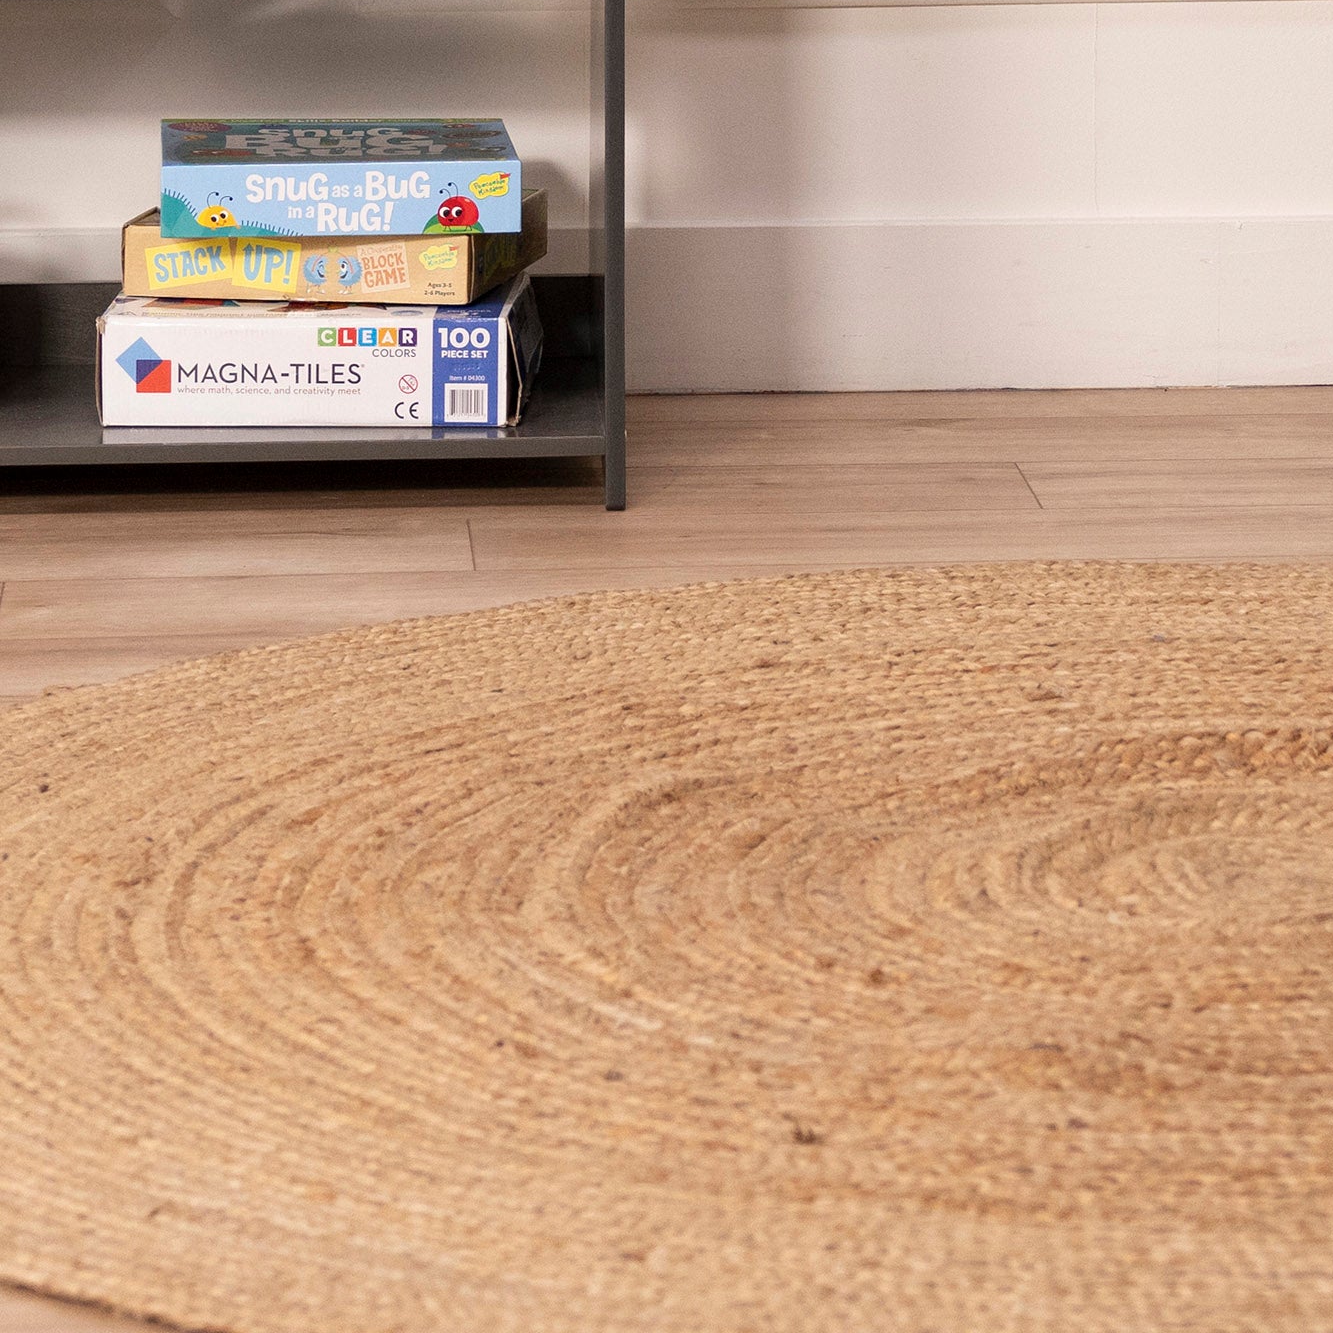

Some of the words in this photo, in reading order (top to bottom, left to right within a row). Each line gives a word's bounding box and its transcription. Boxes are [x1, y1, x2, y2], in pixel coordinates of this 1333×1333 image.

[332, 184, 350, 198] as
[353, 184, 363, 198] a
[287, 206, 302, 219] in
[306, 205, 314, 218] a
[154, 245, 226, 283] STACK
[242, 243, 295, 284] UP!
[361, 253, 404, 270] BLOCK
[364, 267, 406, 288] GAME
[319, 329, 416, 346] CLEAR
[438, 327, 491, 349] 100
[372, 348, 416, 359] COLORS
[441, 350, 469, 359] PIECE
[470, 350, 489, 359] SET
[177, 362, 363, 384] MAGNA-TILES
[177, 386, 205, 394] where
[208, 385, 233, 395] math,
[235, 385, 271, 395] science,
[274, 386, 291, 394] and
[293, 386, 335, 397] creativity
